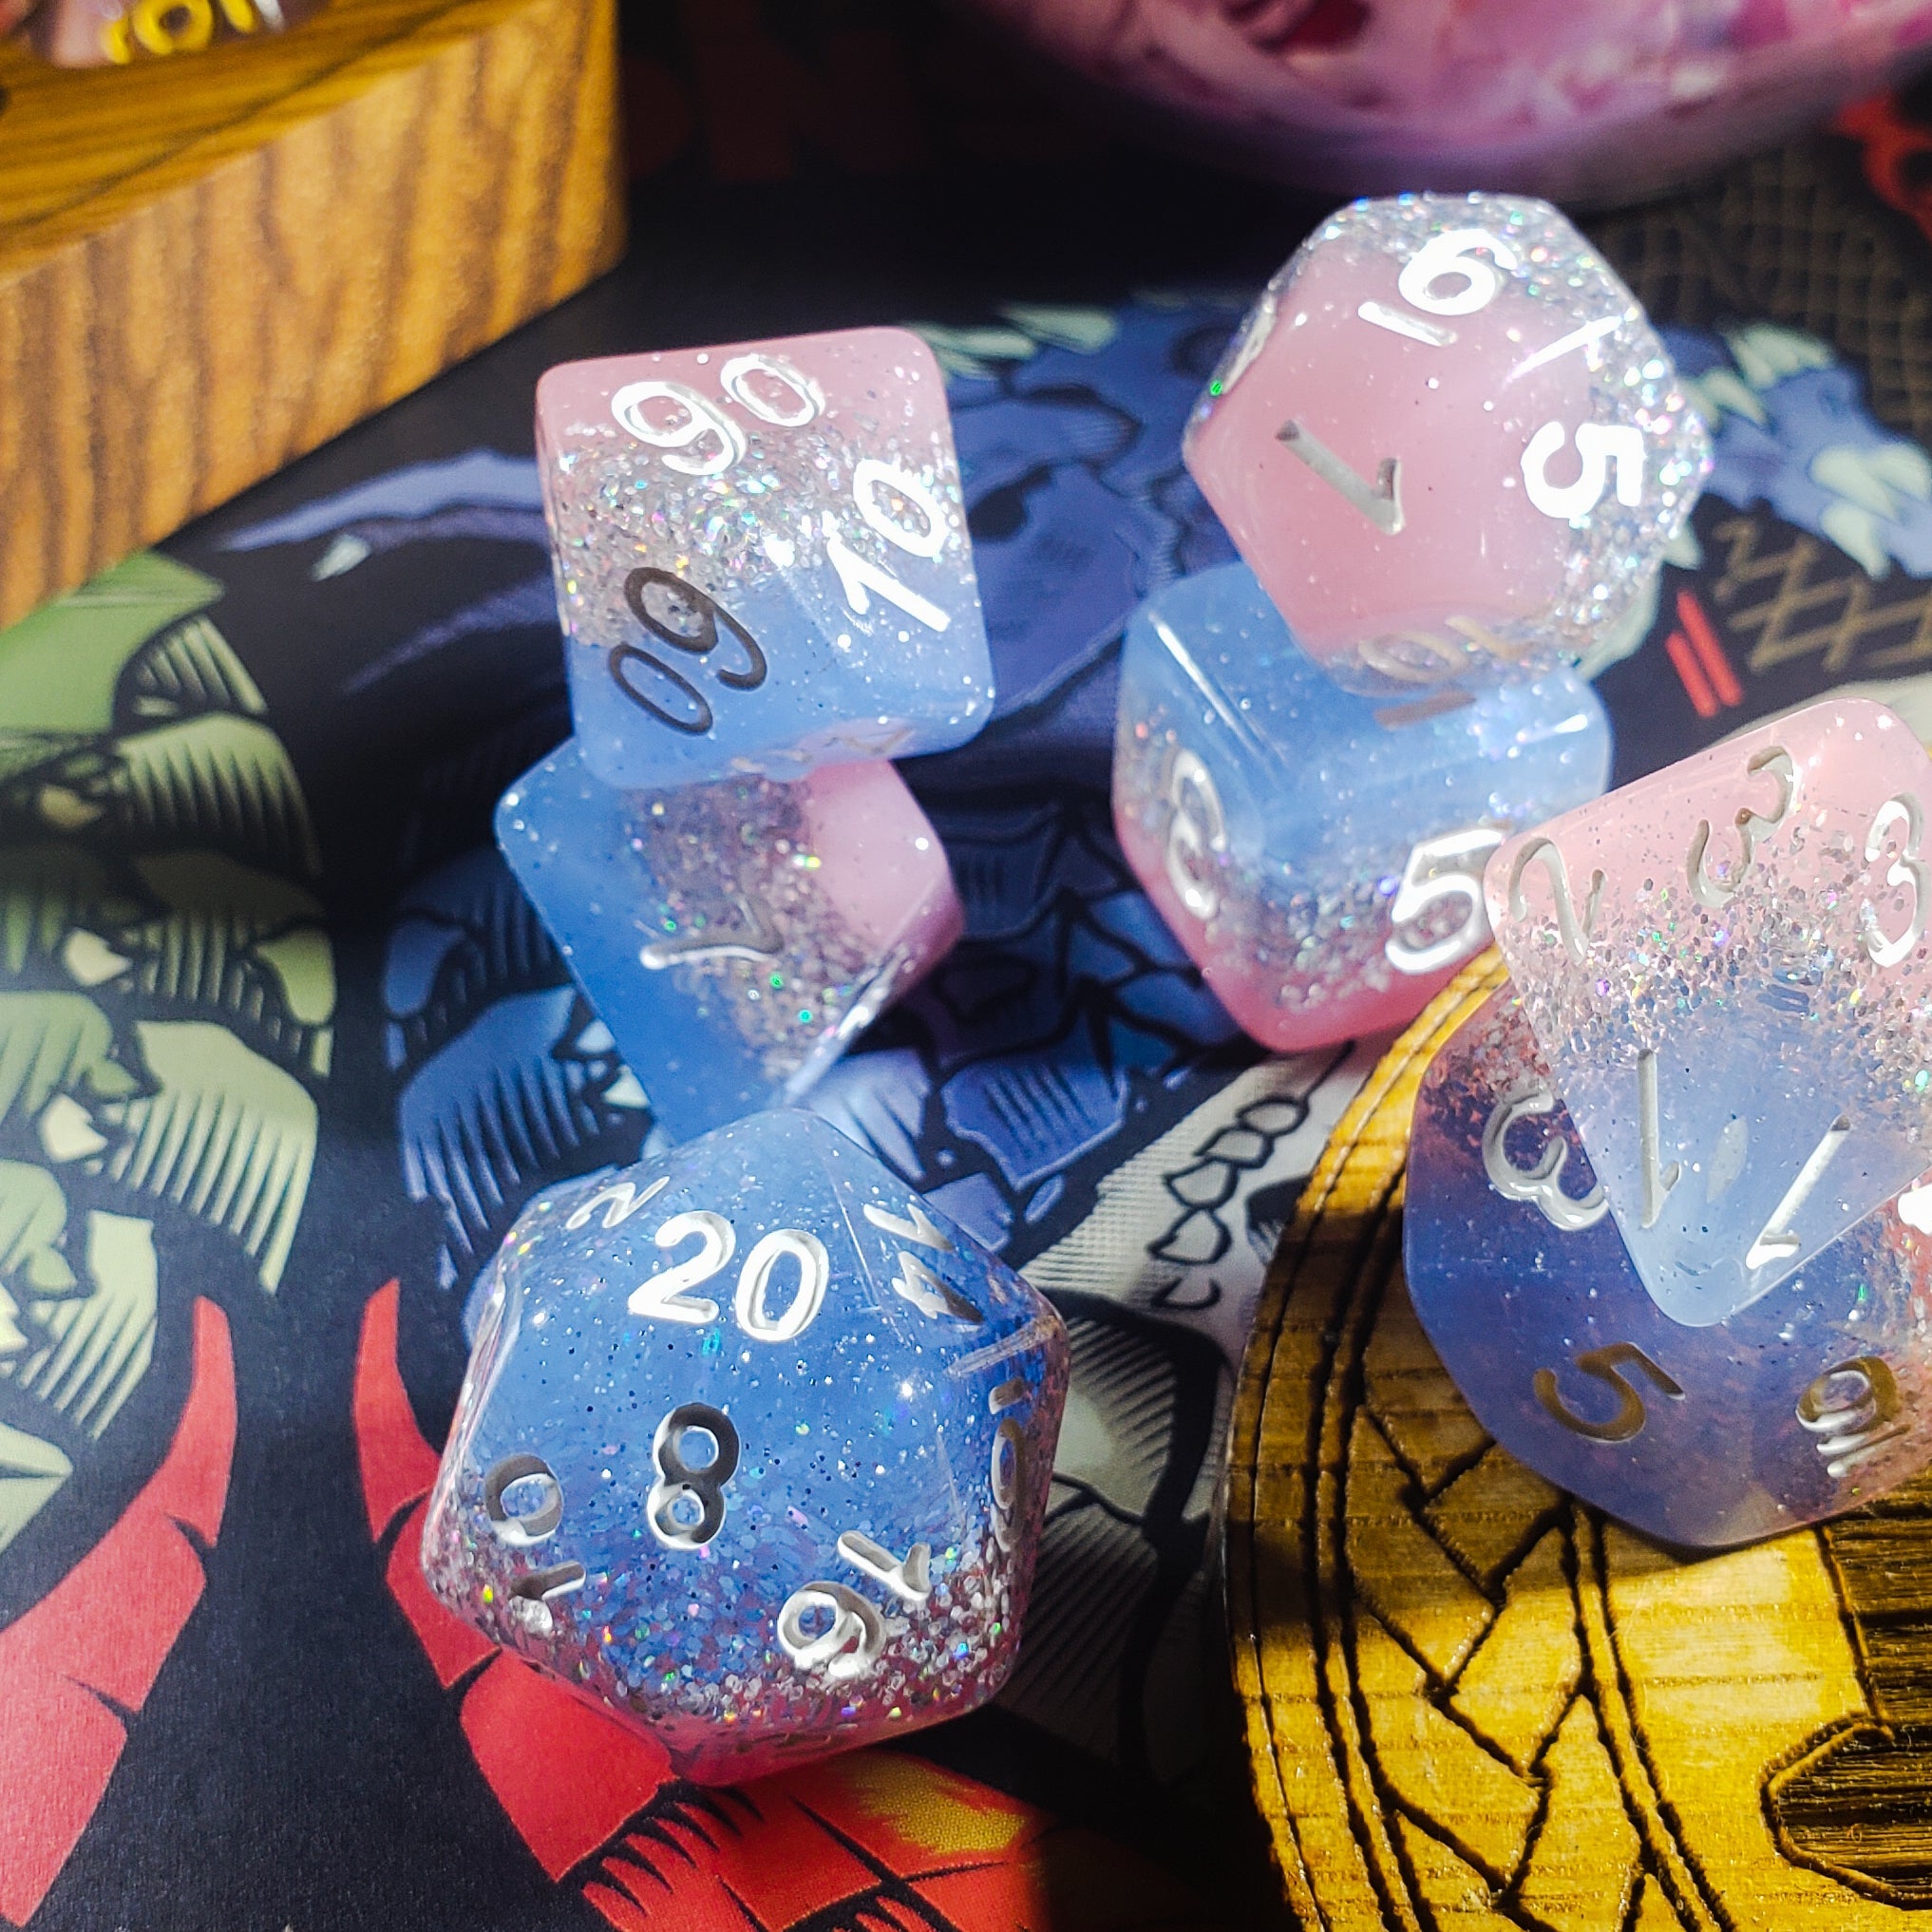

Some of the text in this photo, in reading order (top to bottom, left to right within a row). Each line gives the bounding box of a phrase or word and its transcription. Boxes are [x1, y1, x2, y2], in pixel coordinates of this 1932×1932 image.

[611, 353, 825, 475] 90
[1275, 419, 1407, 536] 1
[1520, 421, 1647, 519] 5
[819, 459, 951, 632] 10
[1686, 745, 1802, 908] 3
[1865, 792, 1932, 968] 3
[1384, 828, 1504, 975] 5
[628, 1209, 829, 1342] 20
[1532, 1341, 1686, 1444] 5
[647, 1401, 742, 1551] 8
